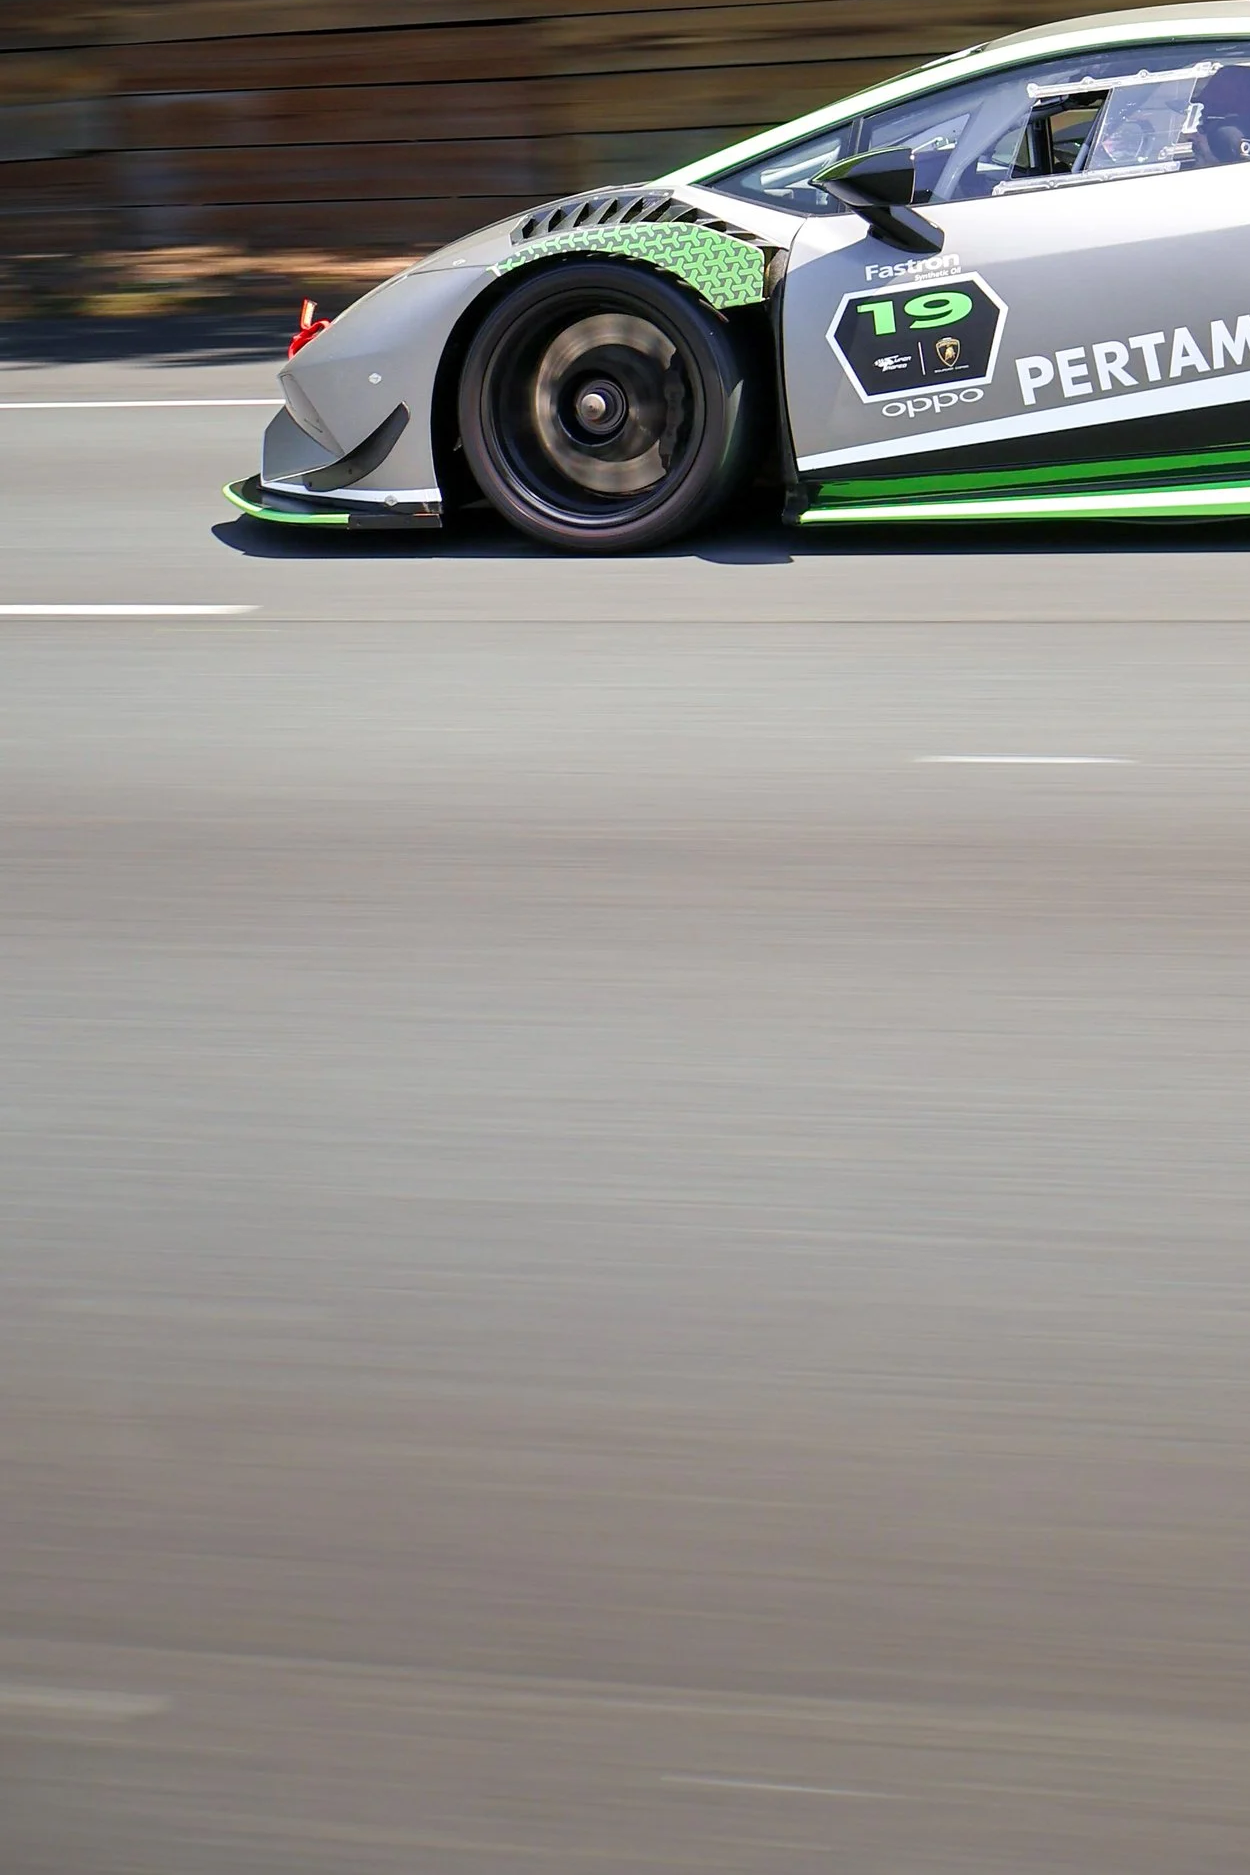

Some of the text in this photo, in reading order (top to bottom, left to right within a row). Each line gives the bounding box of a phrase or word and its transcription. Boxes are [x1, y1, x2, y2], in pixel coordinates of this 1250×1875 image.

[865, 253, 960, 281] Fastron
[914, 266, 961, 281] Synthetic Oil
[857, 292, 972, 335] 19
